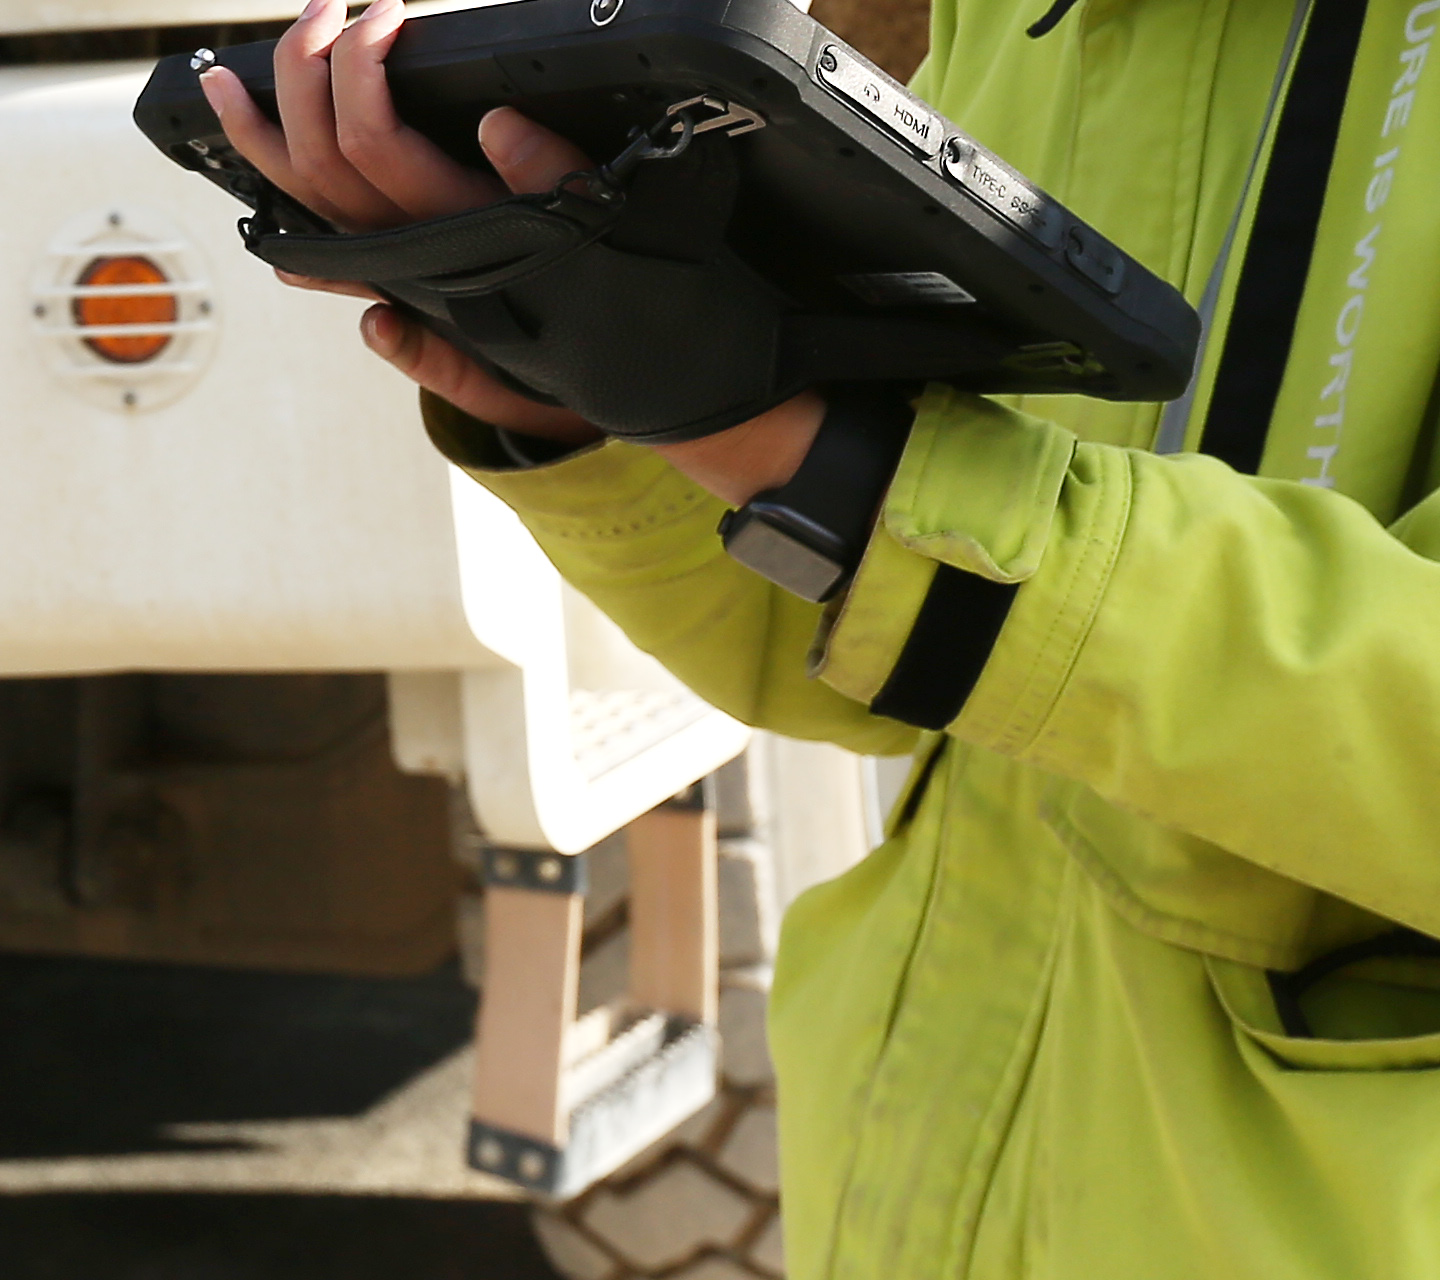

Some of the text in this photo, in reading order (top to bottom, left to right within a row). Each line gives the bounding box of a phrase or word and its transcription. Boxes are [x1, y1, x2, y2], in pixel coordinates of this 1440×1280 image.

[893, 103, 930, 139] HDMI
[972, 165, 1007, 199] TYPE-C
[1364, 145, 1401, 214] IS
[1300, 221, 1383, 488] WORTH
